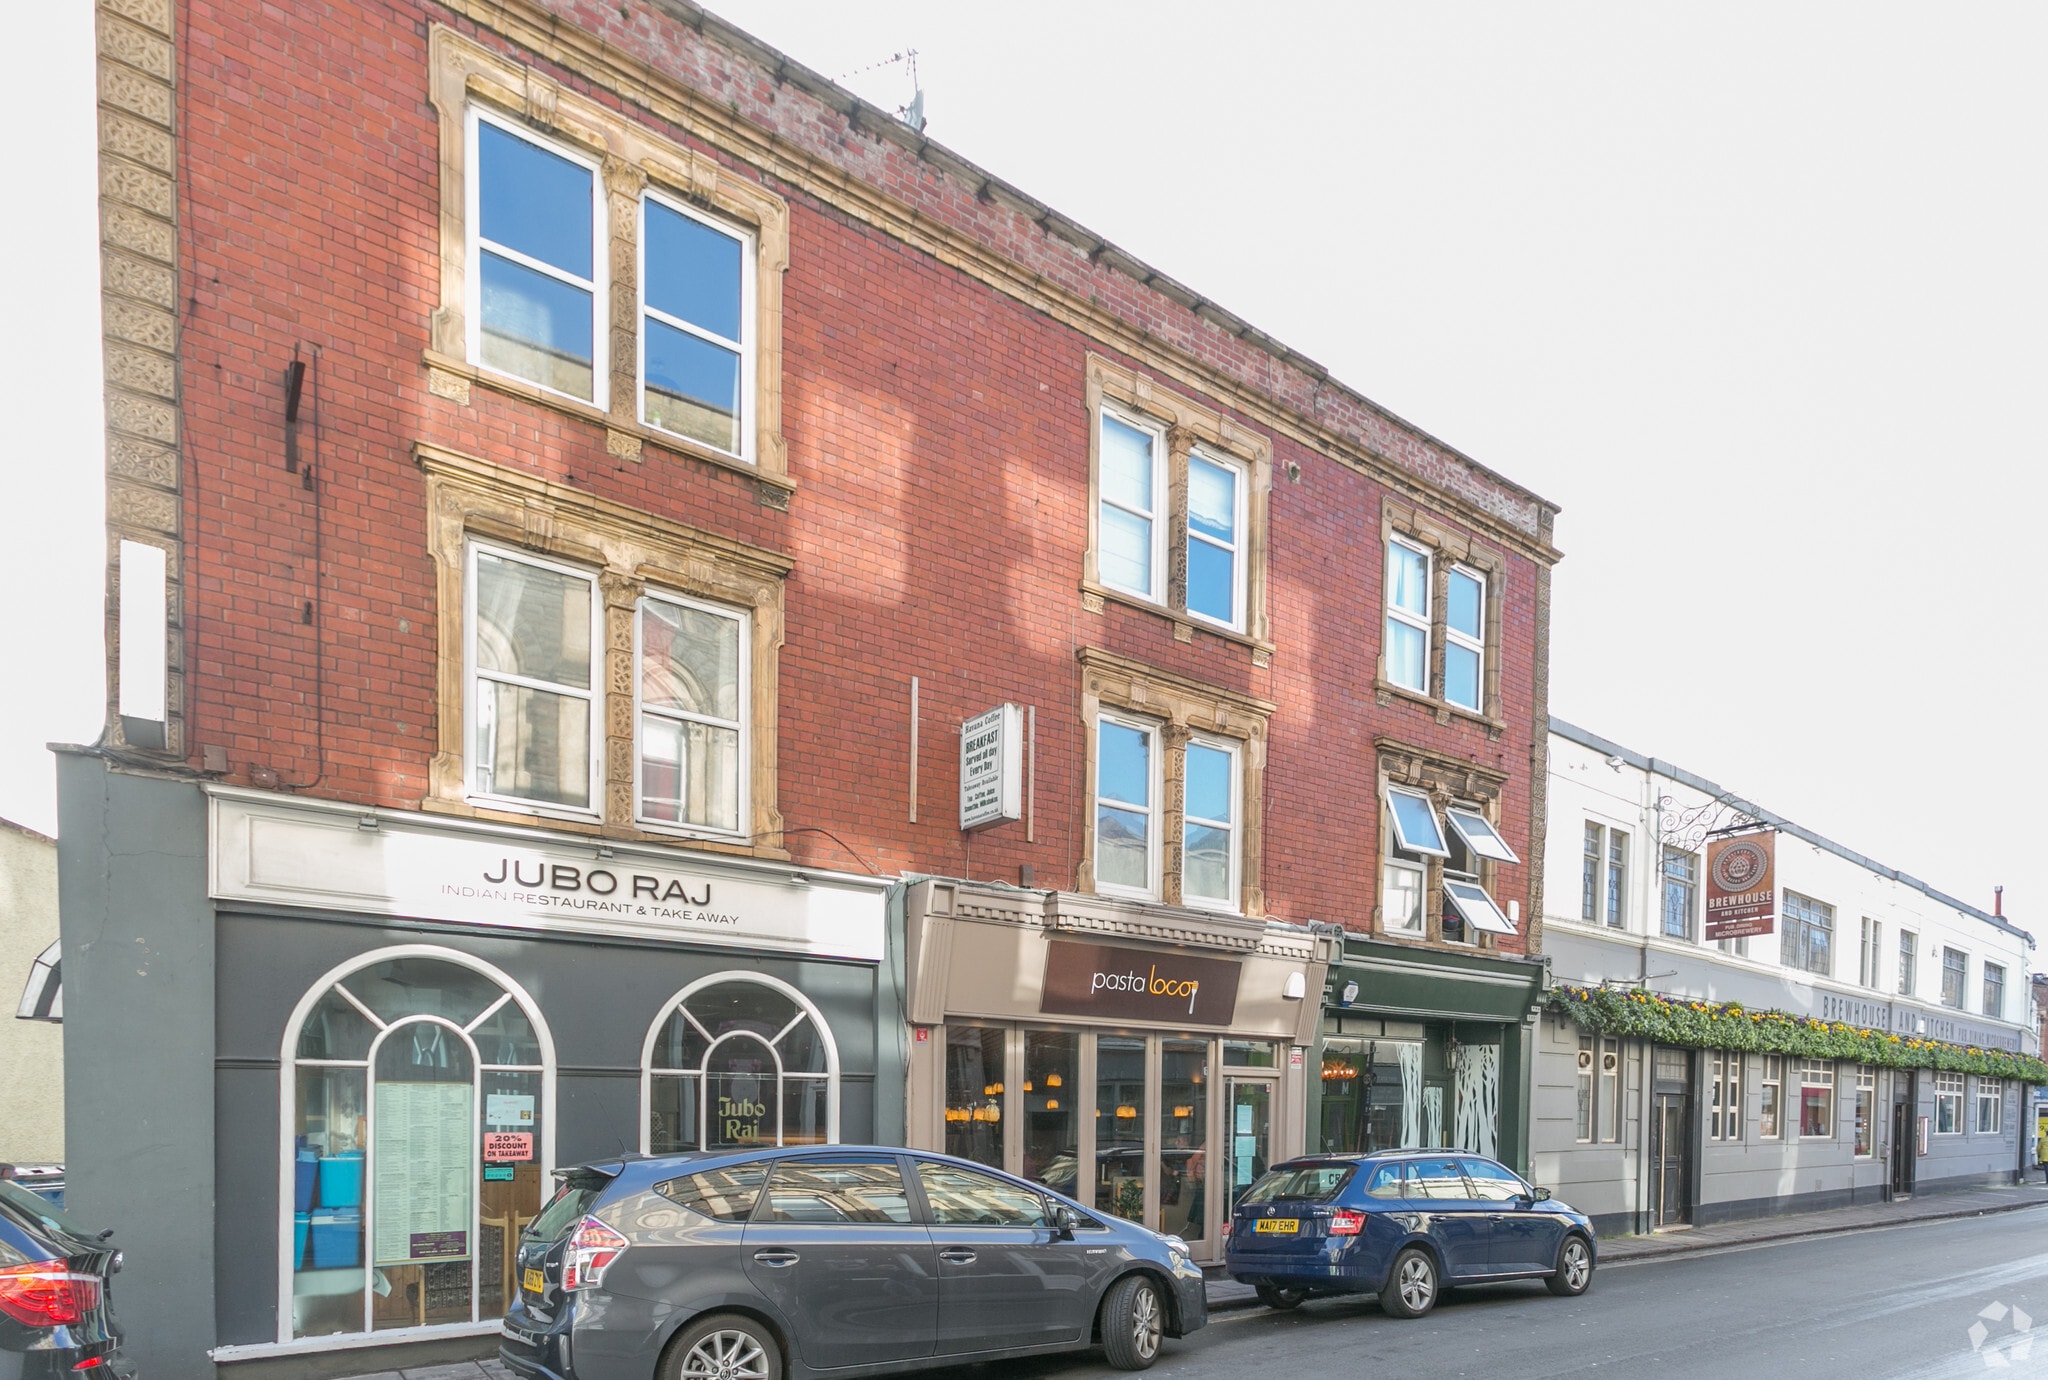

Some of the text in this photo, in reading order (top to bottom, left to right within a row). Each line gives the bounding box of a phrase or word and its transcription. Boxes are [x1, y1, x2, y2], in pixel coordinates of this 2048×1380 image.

[985, 713, 1000, 725] Coffee
[966, 730, 998, 754] BREAKFAST
[966, 752, 981, 766] Served
[989, 747, 997, 757] day
[970, 761, 992, 776] Every Day
[483, 858, 711, 907] JUBO RAJ
[441, 884, 739, 926] INDIAN RESTAURANT & TAKE AWAY
[1709, 890, 1772, 908] BREWHOUSE
[1734, 907, 1759, 915] KITCHEN
[1715, 927, 1762, 938] MICROBREWERY
[1091, 964, 1198, 997] pasta loco
[1823, 995, 1886, 1029] BREWHOUSE
[1899, 1011, 1916, 1033] AND
[718, 1097, 766, 1118] Jubo
[726, 1119, 759, 1142] Raj
[489, 1142, 527, 1150] DISCOUNT
[1259, 1221, 1295, 1230] MA17 EHR
